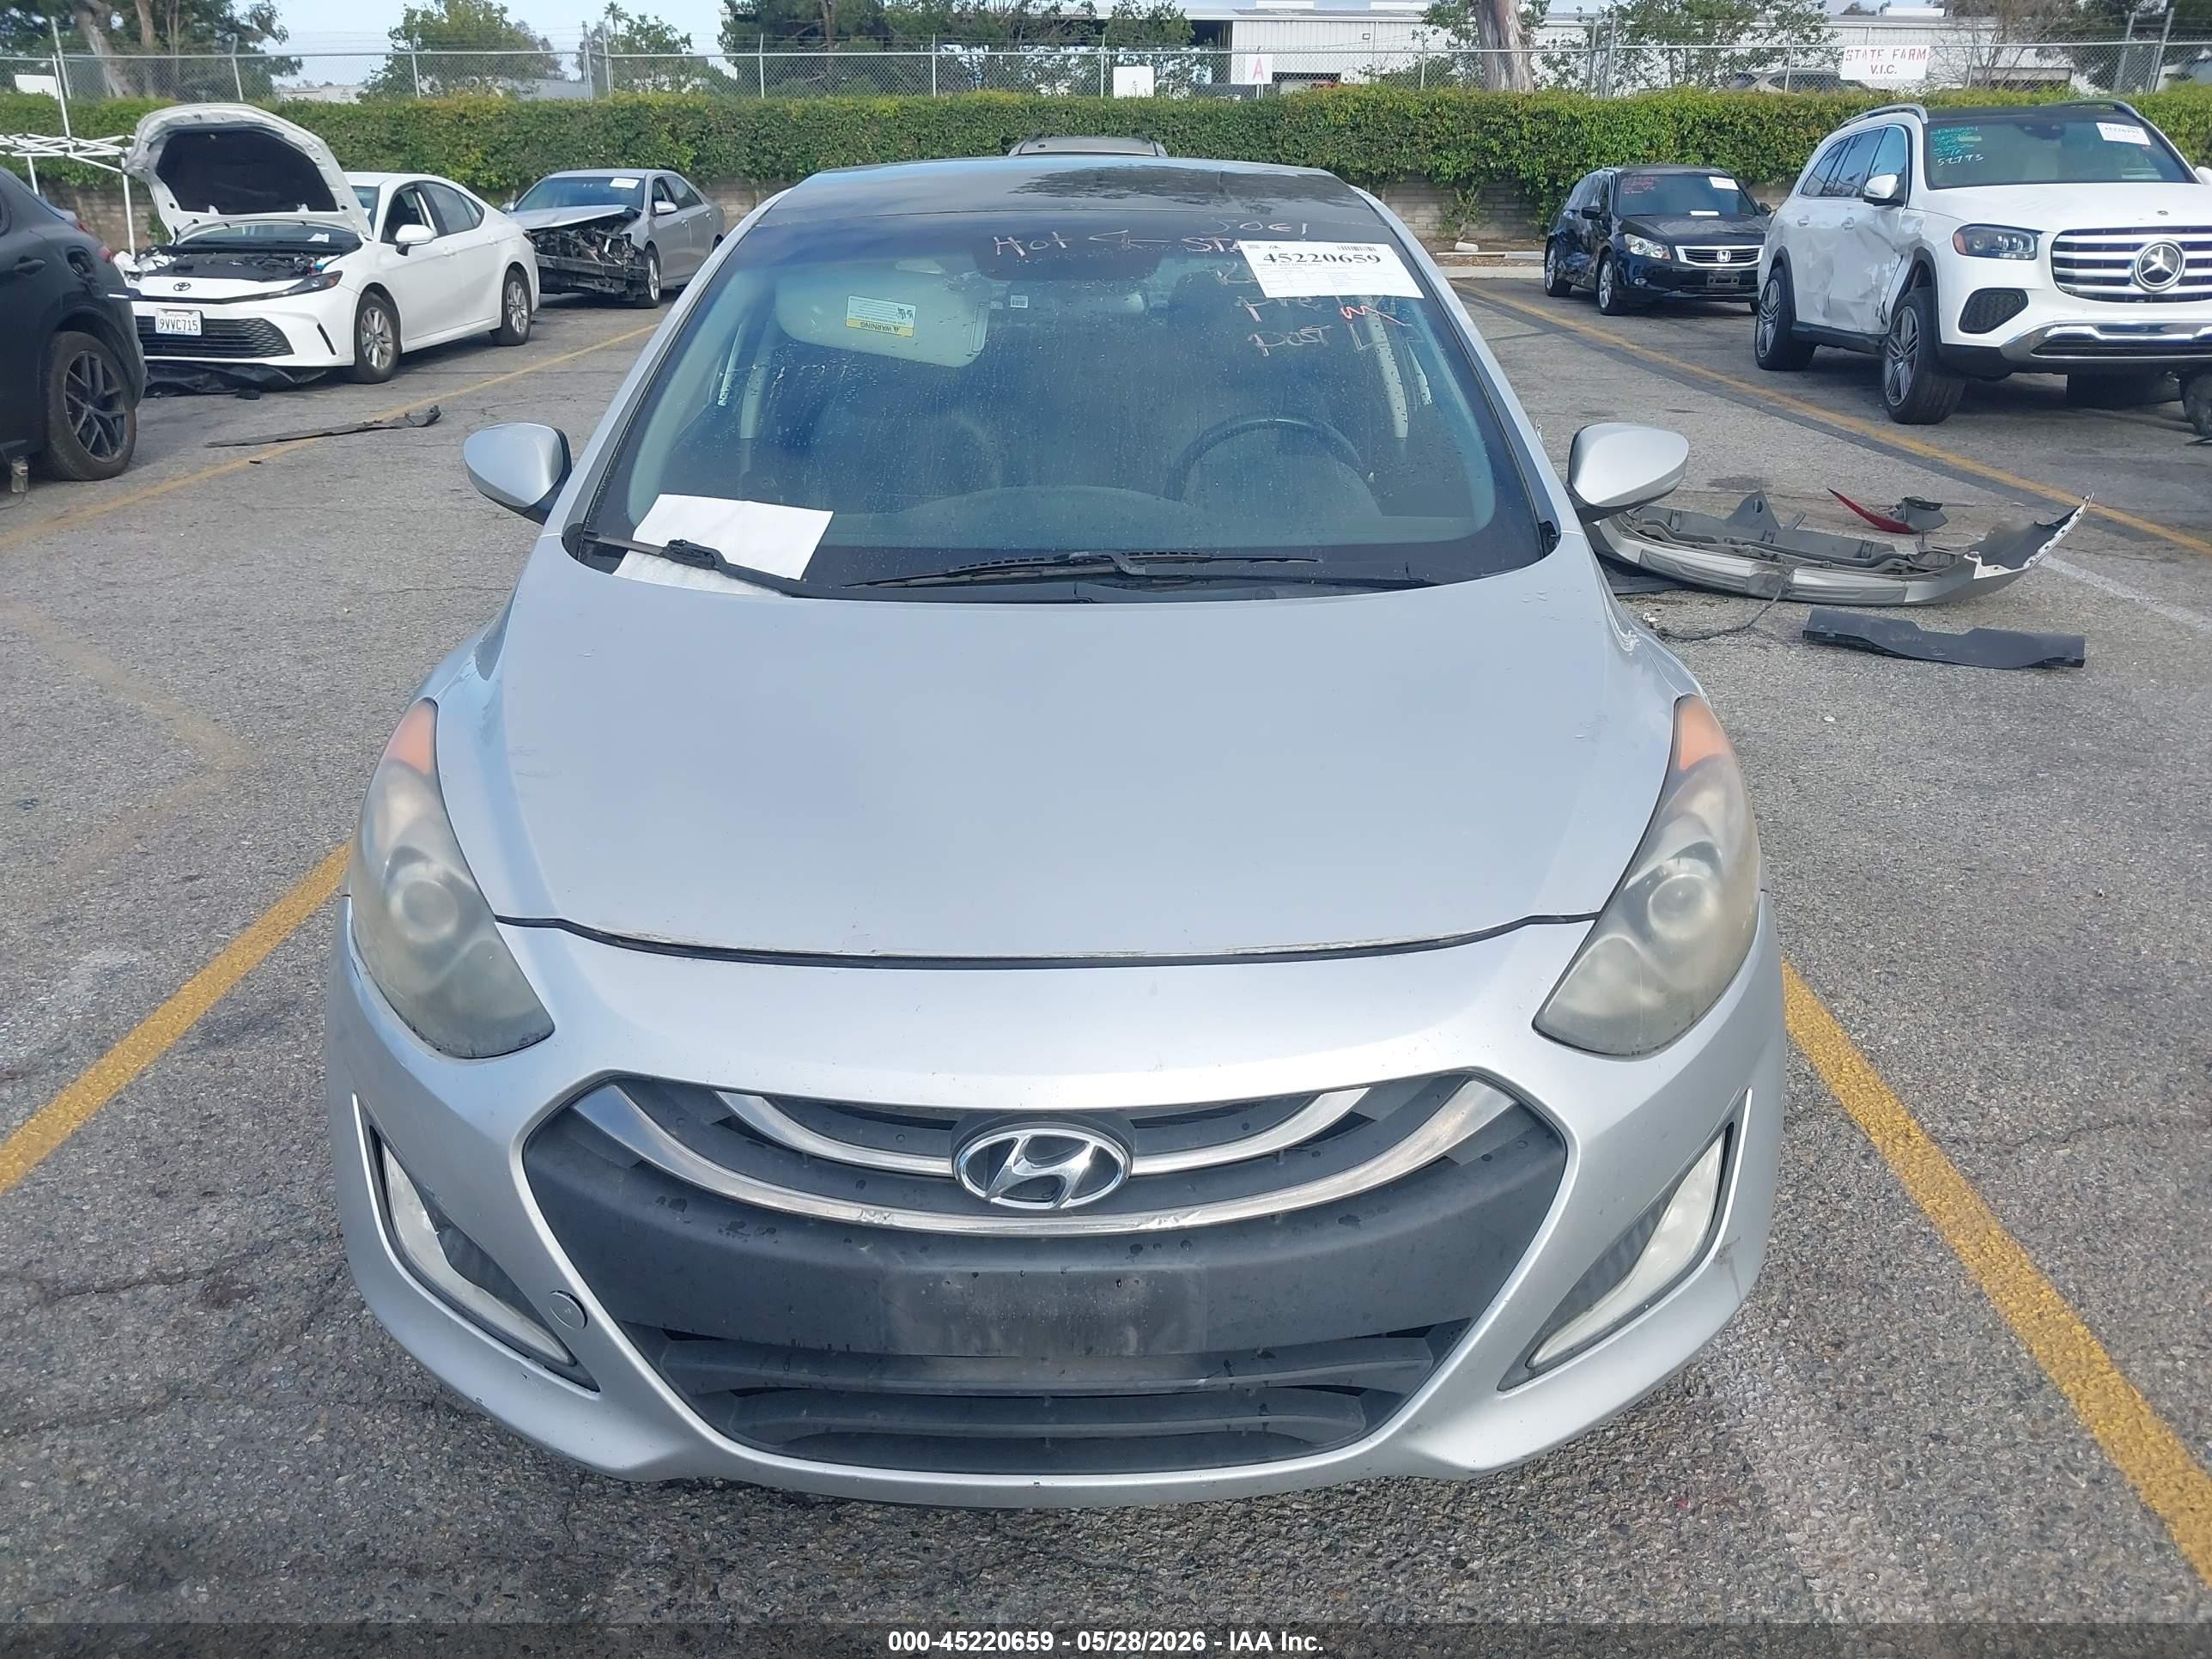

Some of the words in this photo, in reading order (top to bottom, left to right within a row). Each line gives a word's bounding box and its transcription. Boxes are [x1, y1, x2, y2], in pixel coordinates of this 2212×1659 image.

[1845, 49, 1885, 62] STATE
[1892, 48, 1927, 61] FARM
[1251, 56, 1265, 81] A
[1869, 64, 1897, 75] V.I.C.
[1262, 252, 1382, 264] 45220659
[160, 318, 198, 331] 9VVC715
[860, 321, 892, 333] WARNING
